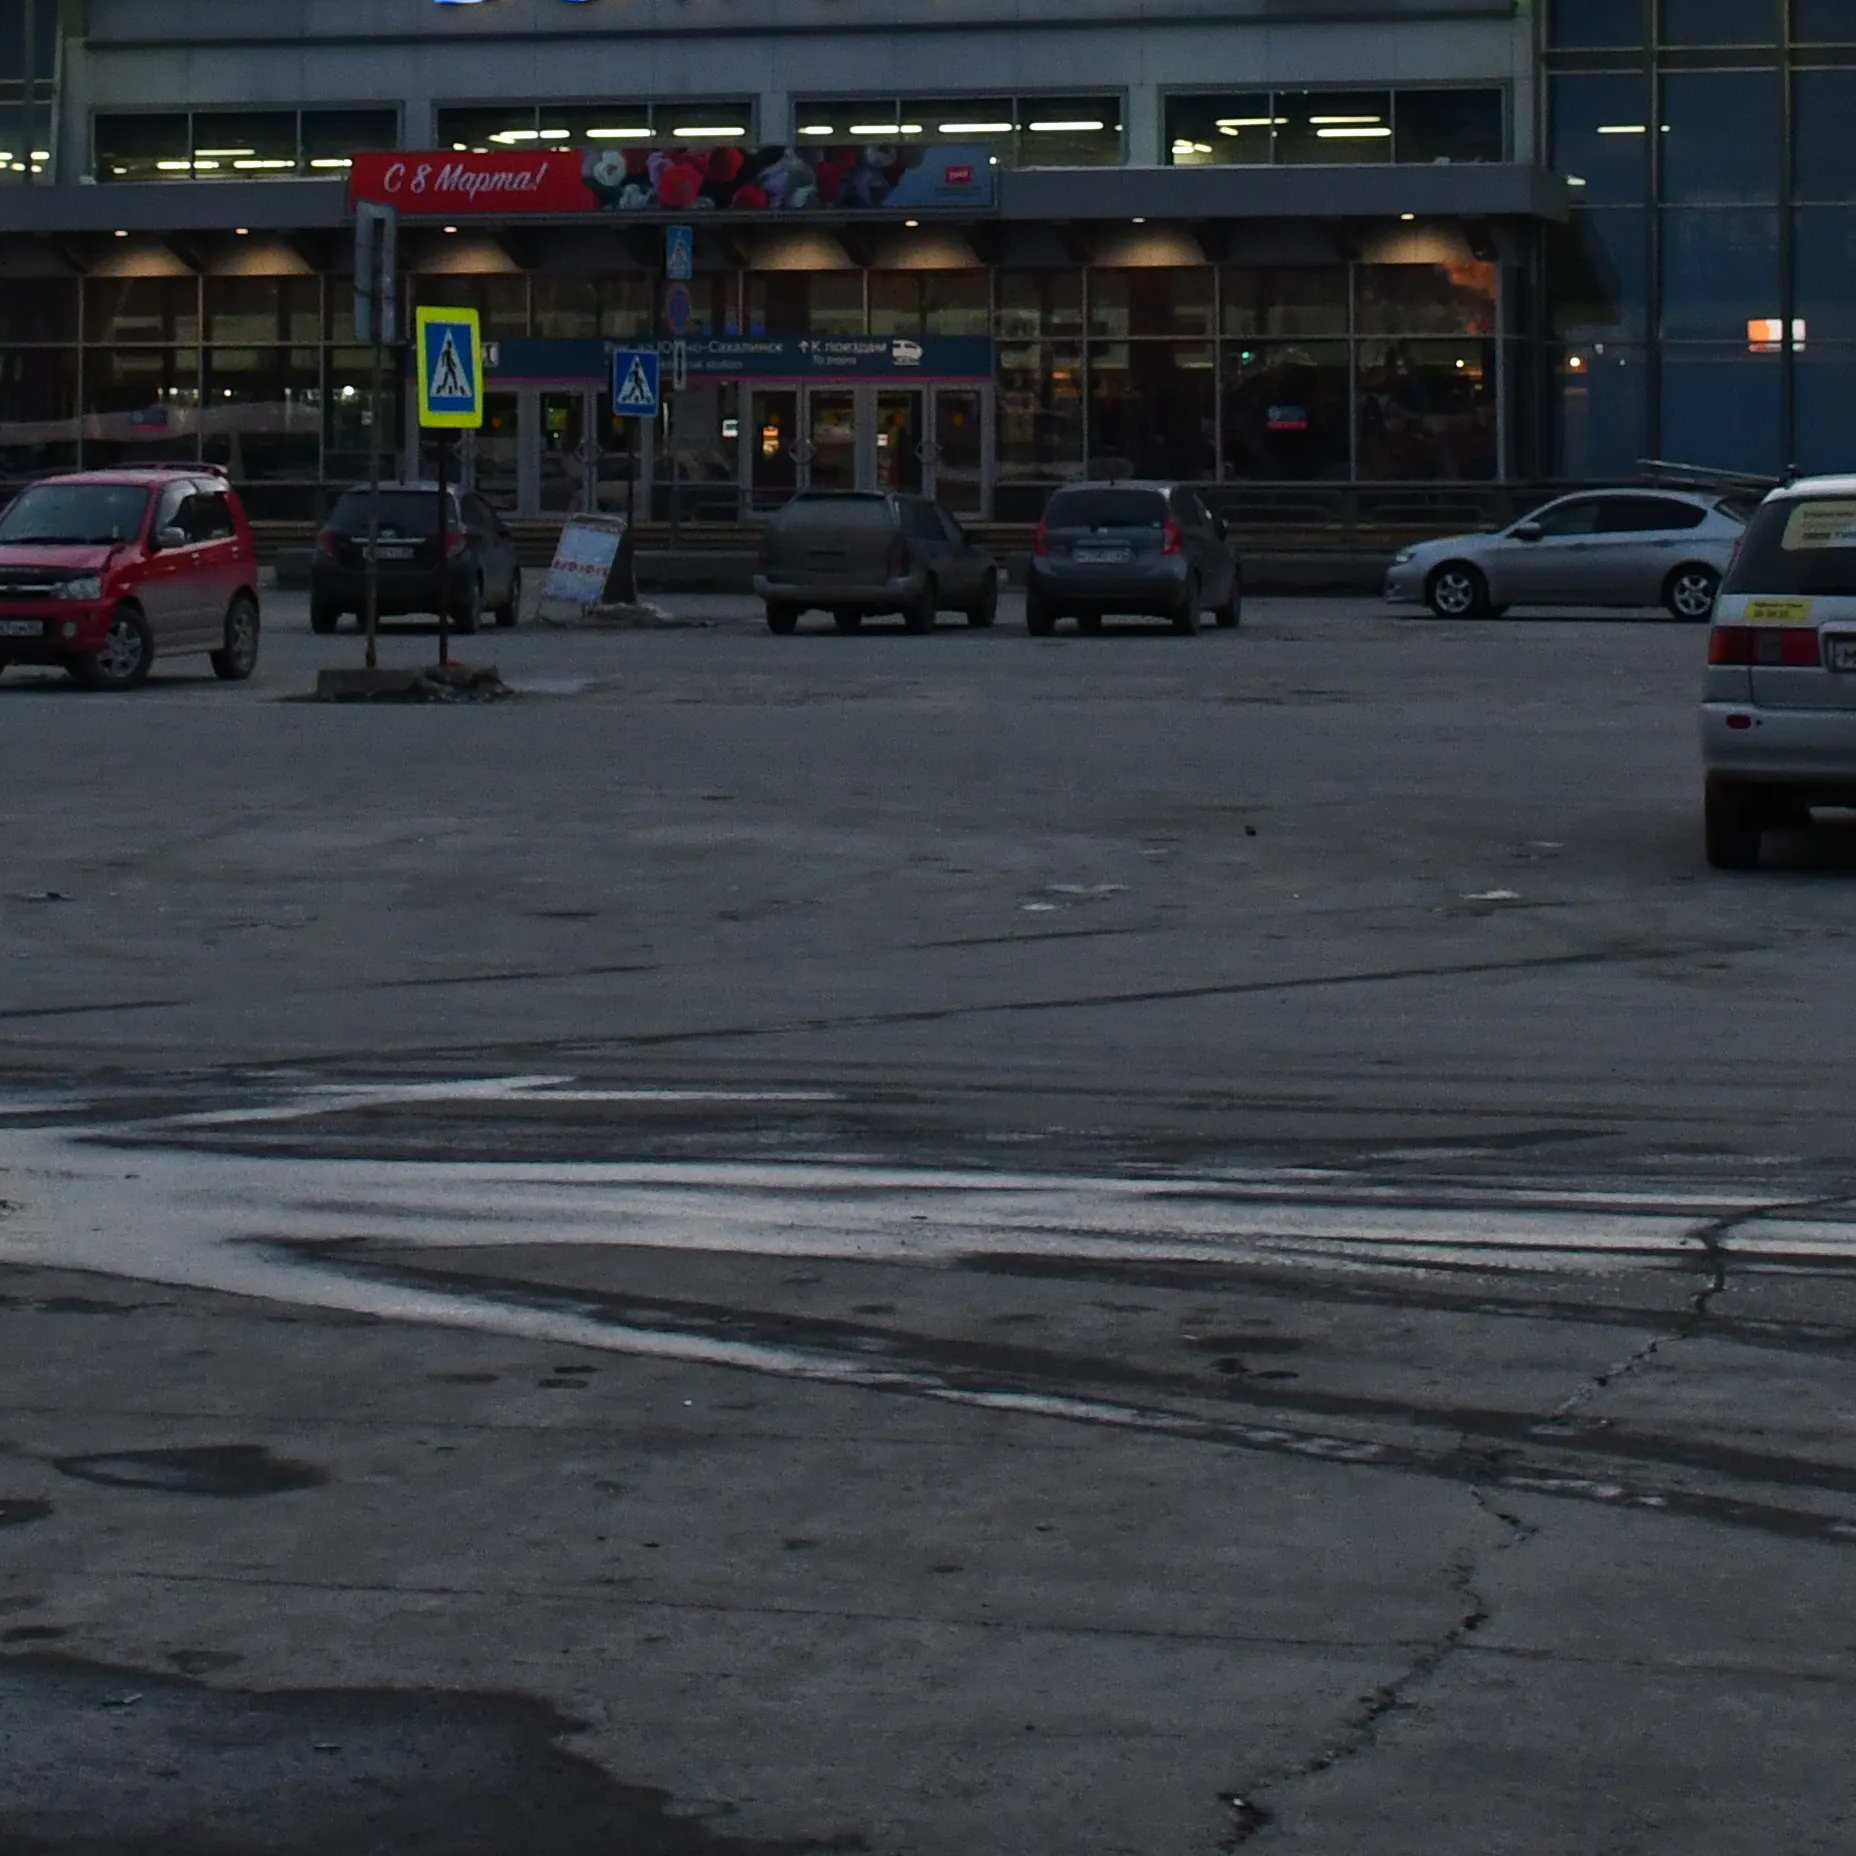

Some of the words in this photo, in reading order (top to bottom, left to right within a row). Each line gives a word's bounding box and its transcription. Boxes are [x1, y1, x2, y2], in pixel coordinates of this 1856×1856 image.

[383, 162, 406, 193] С
[410, 162, 433, 194] 8
[435, 162, 548, 200] Марта!
